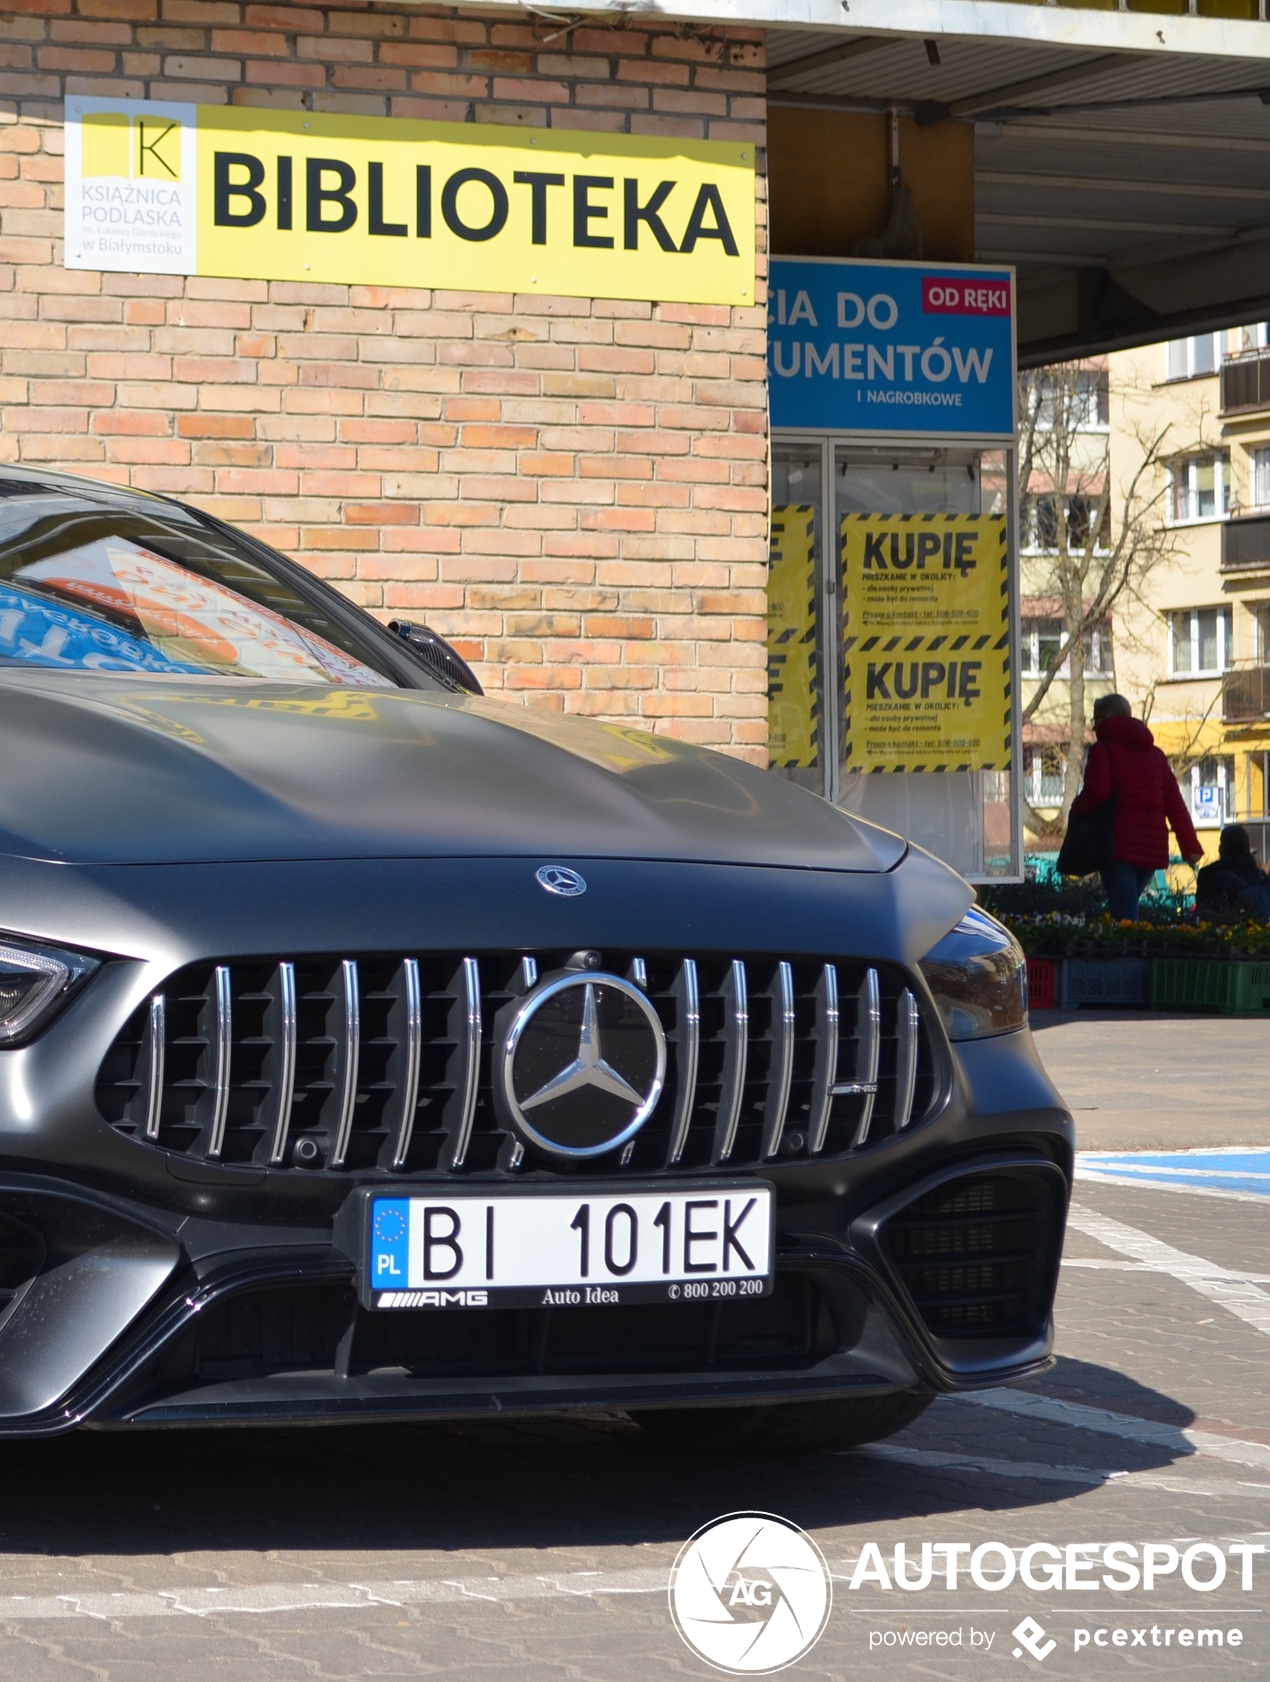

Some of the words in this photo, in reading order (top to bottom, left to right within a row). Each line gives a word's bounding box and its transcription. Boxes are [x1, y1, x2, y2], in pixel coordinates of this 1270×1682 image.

[82, 183, 182, 207] KSIĄŻNICA
[213, 151, 740, 257] BIBLIOTEKA
[82, 206, 182, 227] PODLASKA
[82, 225, 95, 235] im.
[97, 226, 130, 236] Łukasza
[132, 227, 182, 240] Górnickiego
[82, 240, 95, 250] w
[99, 238, 182, 255] Białymstoku
[768, 288, 819, 327] IA
[837, 292, 899, 331] DO
[928, 286, 960, 307] OD
[964, 288, 1007, 312] RĘKI
[767, 337, 994, 384] UMENTÓW
[866, 390, 963, 407] NAGROBKOWE
[863, 532, 979, 577] KUPIĘ
[862, 573, 907, 581] MIESZKANIE
[910, 573, 918, 581] W
[920, 573, 956, 581] OKOLICY:
[878, 585, 899, 593] osoby
[899, 584, 934, 593] prywatnej
[866, 661, 982, 707] KUPIĘ
[866, 703, 911, 711] MIESZKANIE
[924, 702, 960, 710] OKOLICY:
[881, 714, 902, 723] osoby
[903, 713, 938, 723] prywatnej
[423, 1205, 495, 1281] BI
[570, 1198, 758, 1278] 101EK
[377, 1254, 401, 1275] PL
[417, 1290, 488, 1307] AMG
[541, 1288, 580, 1304] Auto
[585, 1287, 619, 1304] Idea
[684, 1283, 709, 1298] 800
[712, 1281, 736, 1297] 200
[739, 1280, 763, 1294] 200
